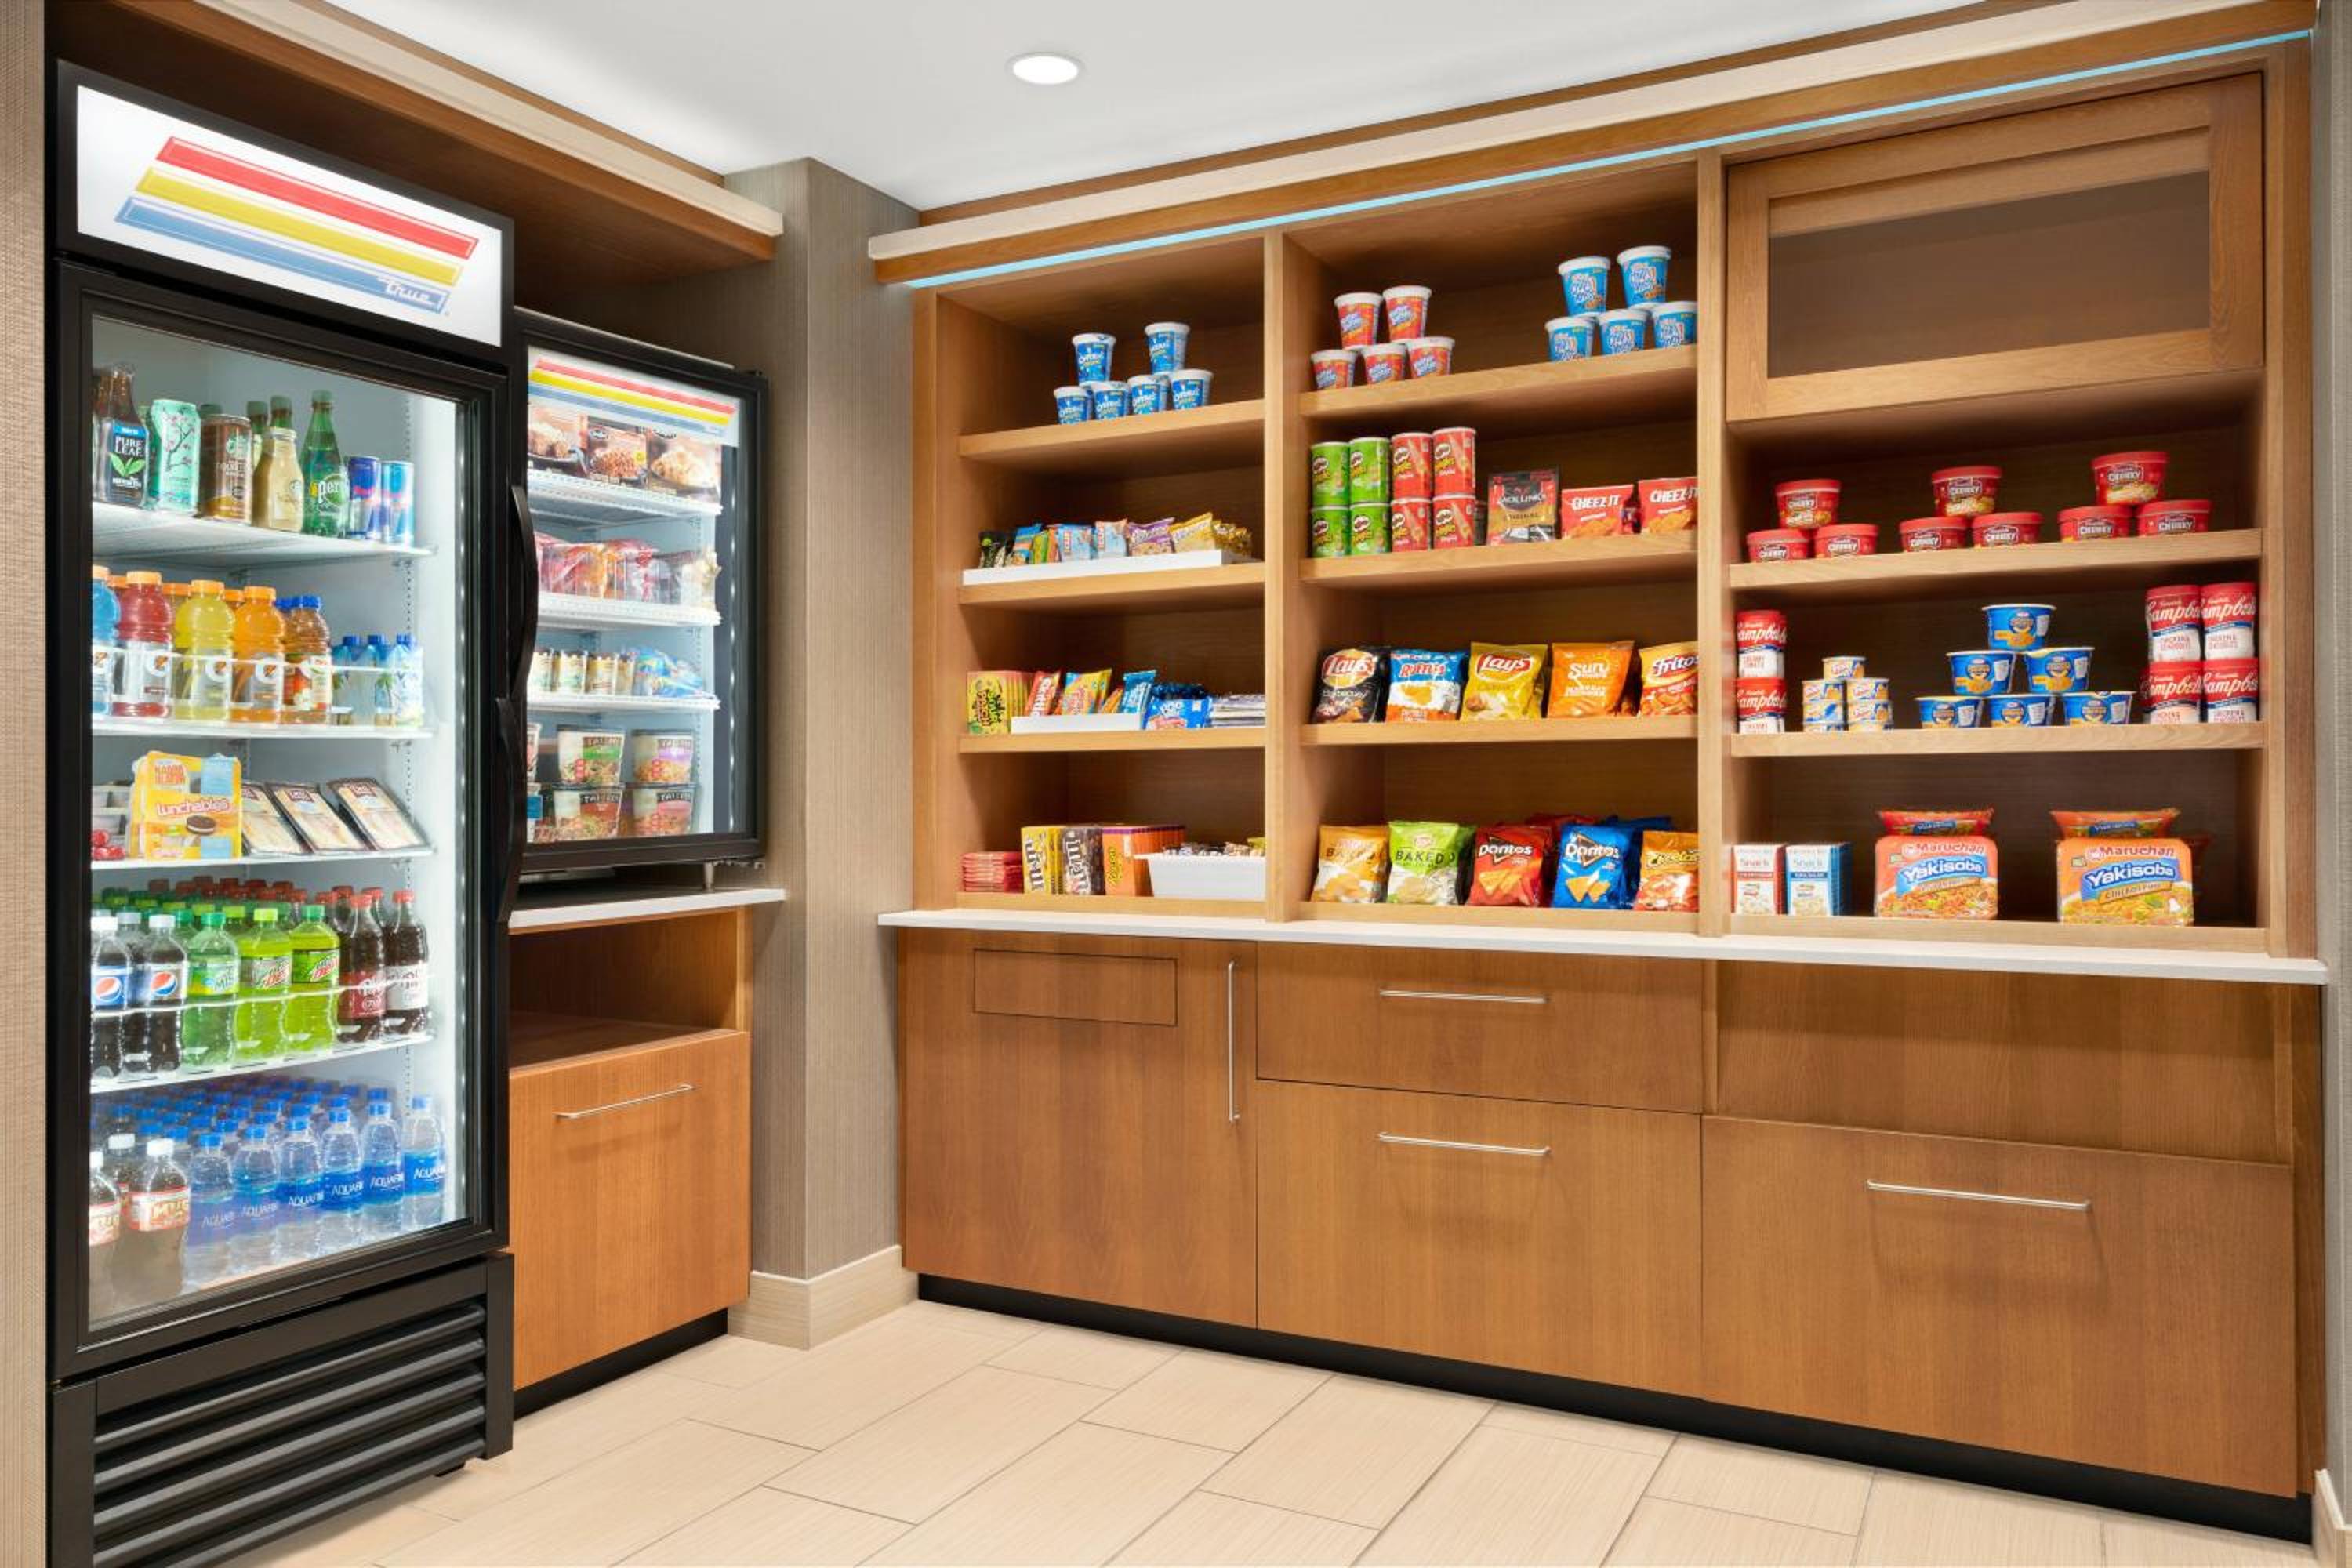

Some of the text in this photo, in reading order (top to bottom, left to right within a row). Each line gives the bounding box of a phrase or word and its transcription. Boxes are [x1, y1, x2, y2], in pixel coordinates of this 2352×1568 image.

[115, 437, 144, 448] PURE
[115, 445, 144, 457] LEAF
[1650, 488, 1686, 503] CHEEZ
[1571, 496, 1606, 511] CHEEZ
[157, 797, 230, 816] Lunchables
[1479, 844, 1533, 857] Doritos
[1919, 842, 1984, 855] Maruchan
[2100, 844, 2175, 857] Maruchan
[1395, 850, 1444, 865] BAKED
[1904, 858, 1983, 883] Yakisoba
[2087, 862, 2175, 888] Yakisoba
